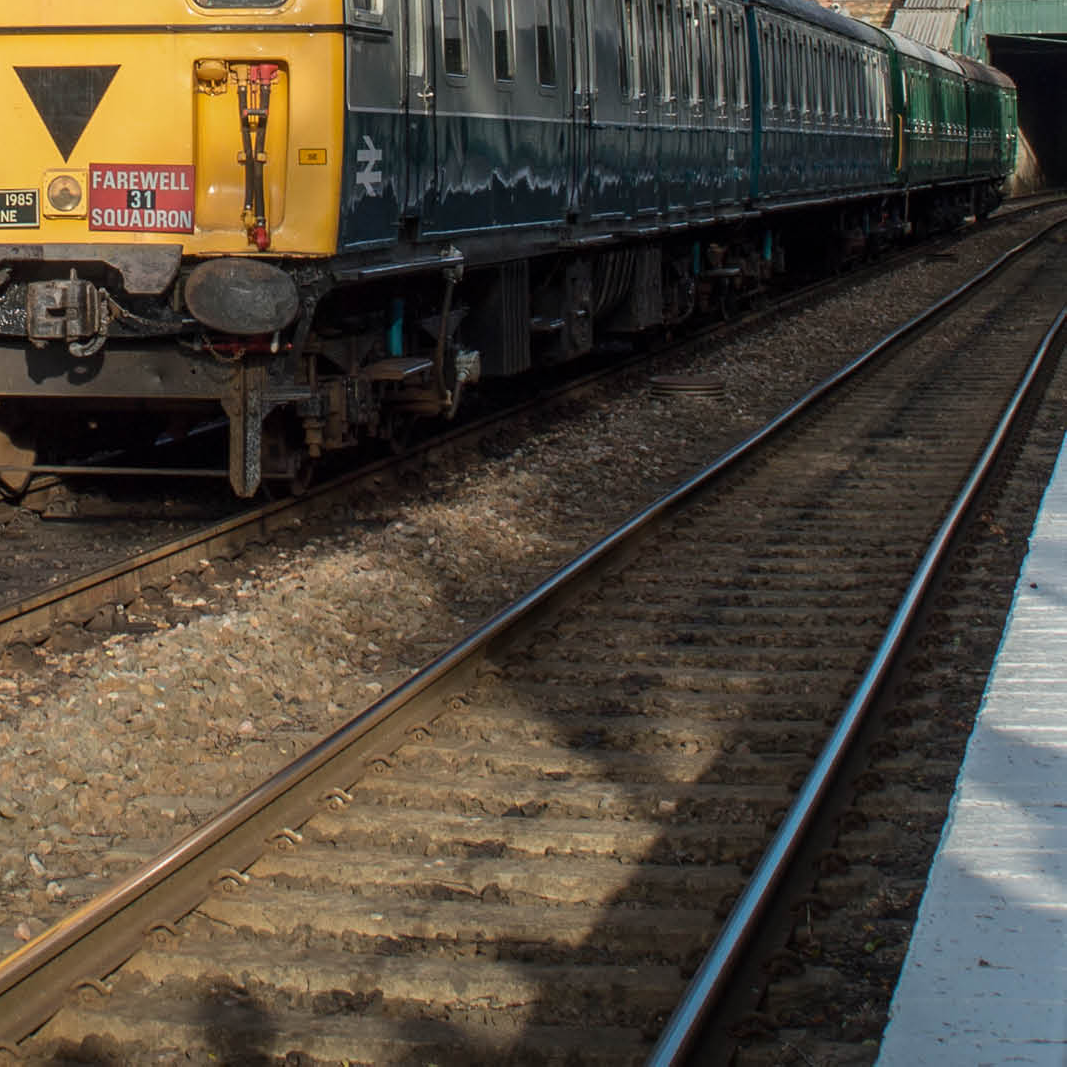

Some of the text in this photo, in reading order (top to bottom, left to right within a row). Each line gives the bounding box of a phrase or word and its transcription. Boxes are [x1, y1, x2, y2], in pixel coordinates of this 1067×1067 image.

[92, 170, 190, 191] FAREWELL
[5, 193, 33, 206] 1985
[130, 190, 153, 208] 31
[91, 208, 192, 229] SQUADRON
